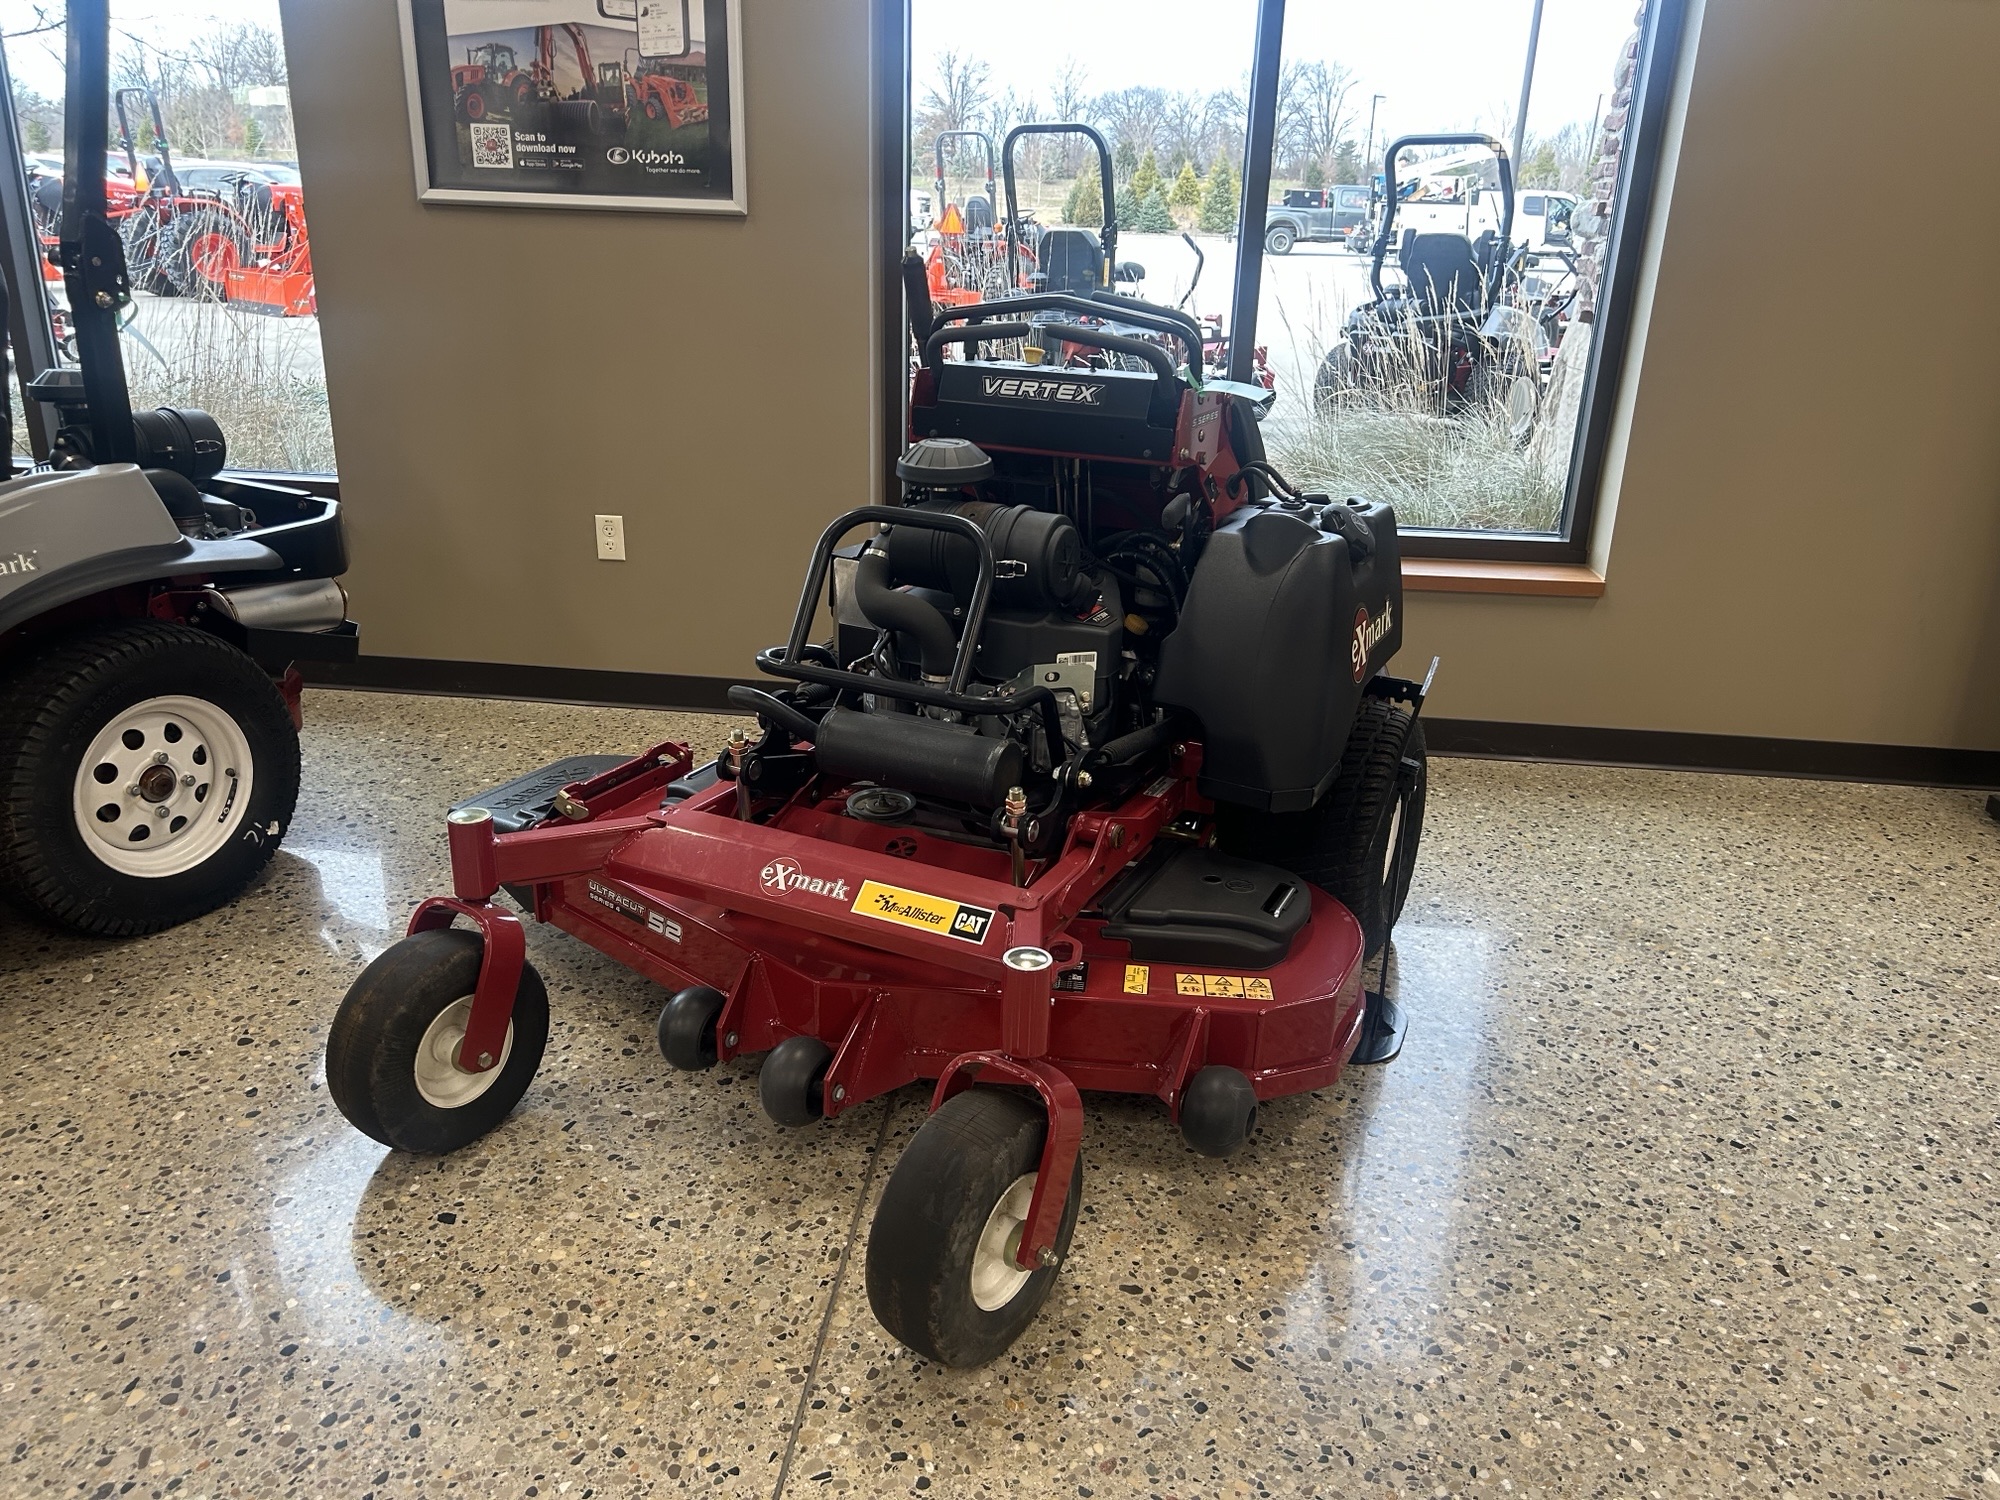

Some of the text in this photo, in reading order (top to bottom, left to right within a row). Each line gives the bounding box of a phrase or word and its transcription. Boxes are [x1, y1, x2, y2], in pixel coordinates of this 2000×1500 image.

[514, 131, 546, 142] Scan to
[516, 143, 576, 154] download now
[632, 149, 684, 165] Kubota
[646, 166, 669, 174] Together
[983, 377, 1103, 404] VERTEX
[1351, 600, 1392, 673] eXmark
[760, 862, 850, 901] eXmark
[588, 879, 646, 916] ULTRACUT
[615, 905, 621, 913] 4
[648, 909, 683, 945] 52
[879, 899, 987, 935] MacAllister CAT
